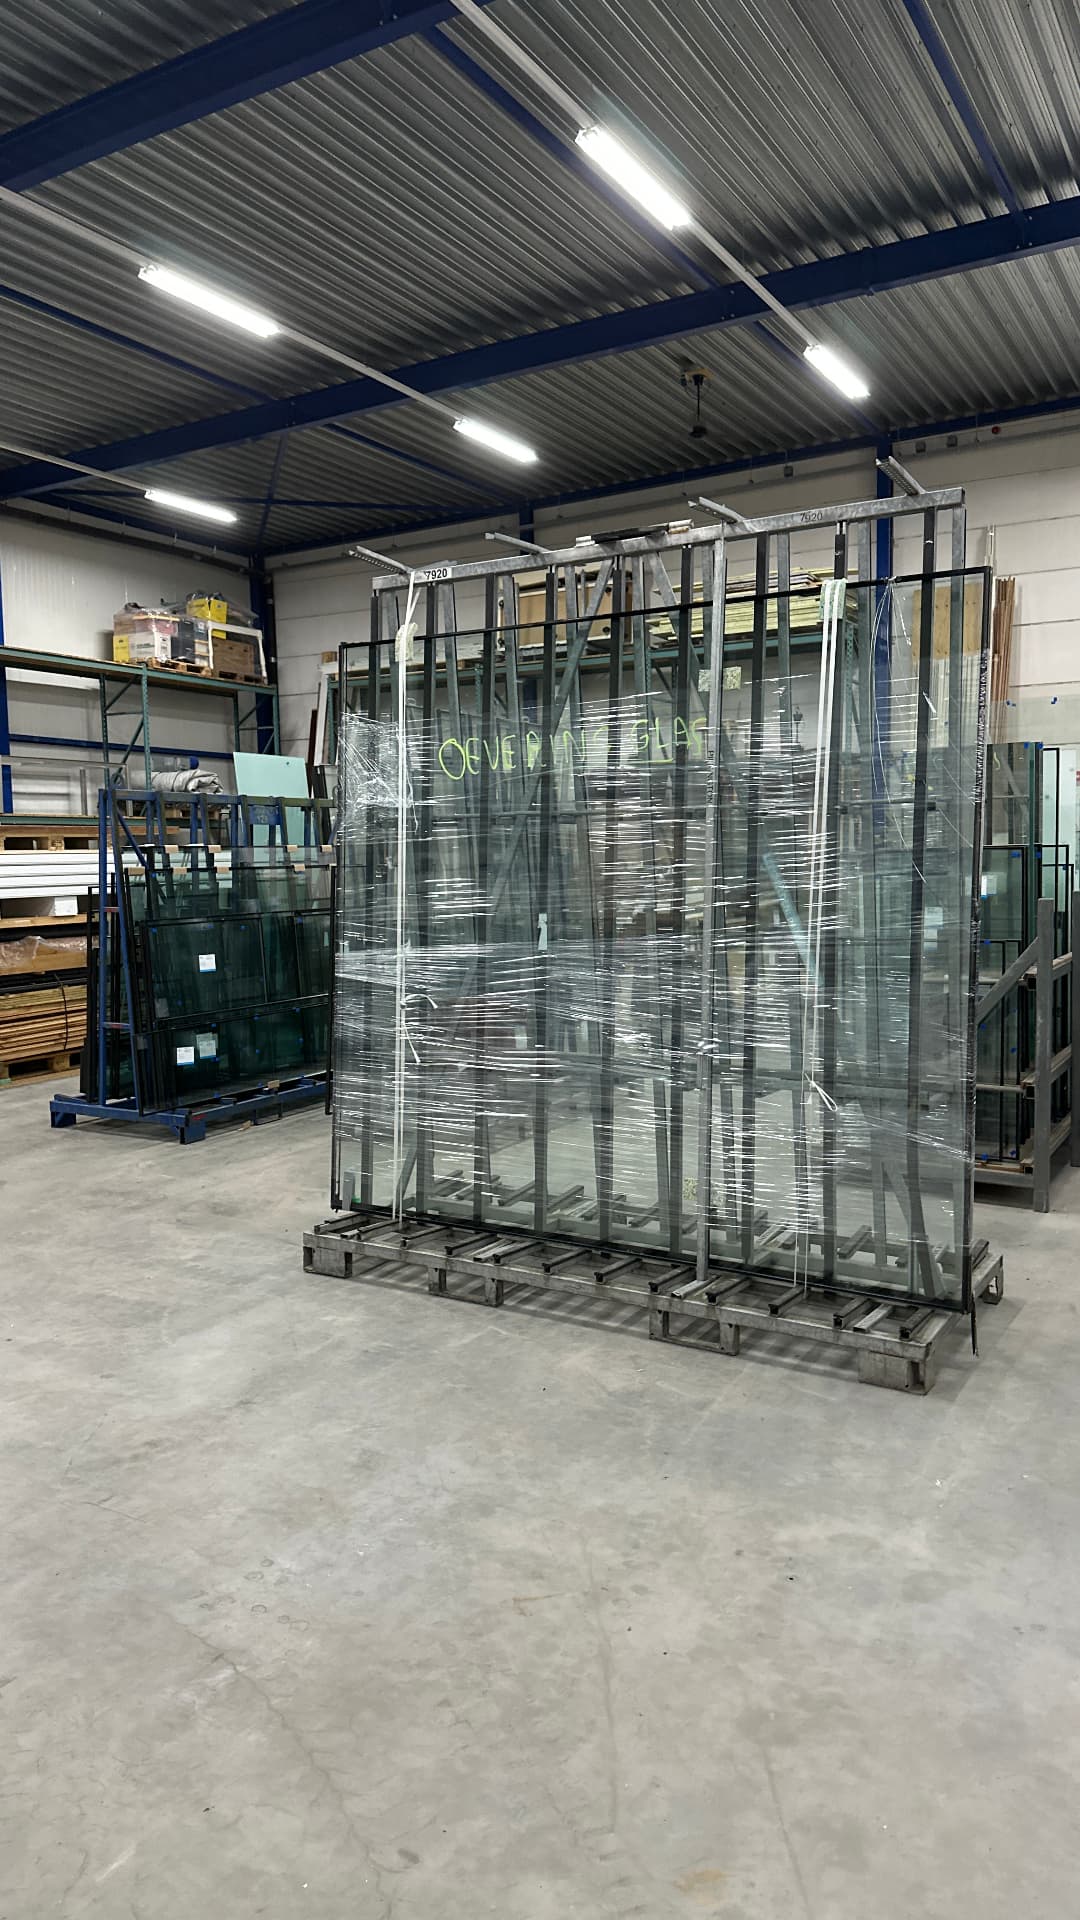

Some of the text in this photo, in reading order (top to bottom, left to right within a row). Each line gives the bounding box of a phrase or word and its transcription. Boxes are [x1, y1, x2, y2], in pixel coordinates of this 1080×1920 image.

[800, 511, 822, 522] 7920
[425, 568, 448, 580] 7920
[631, 717, 707, 756] GLAS
